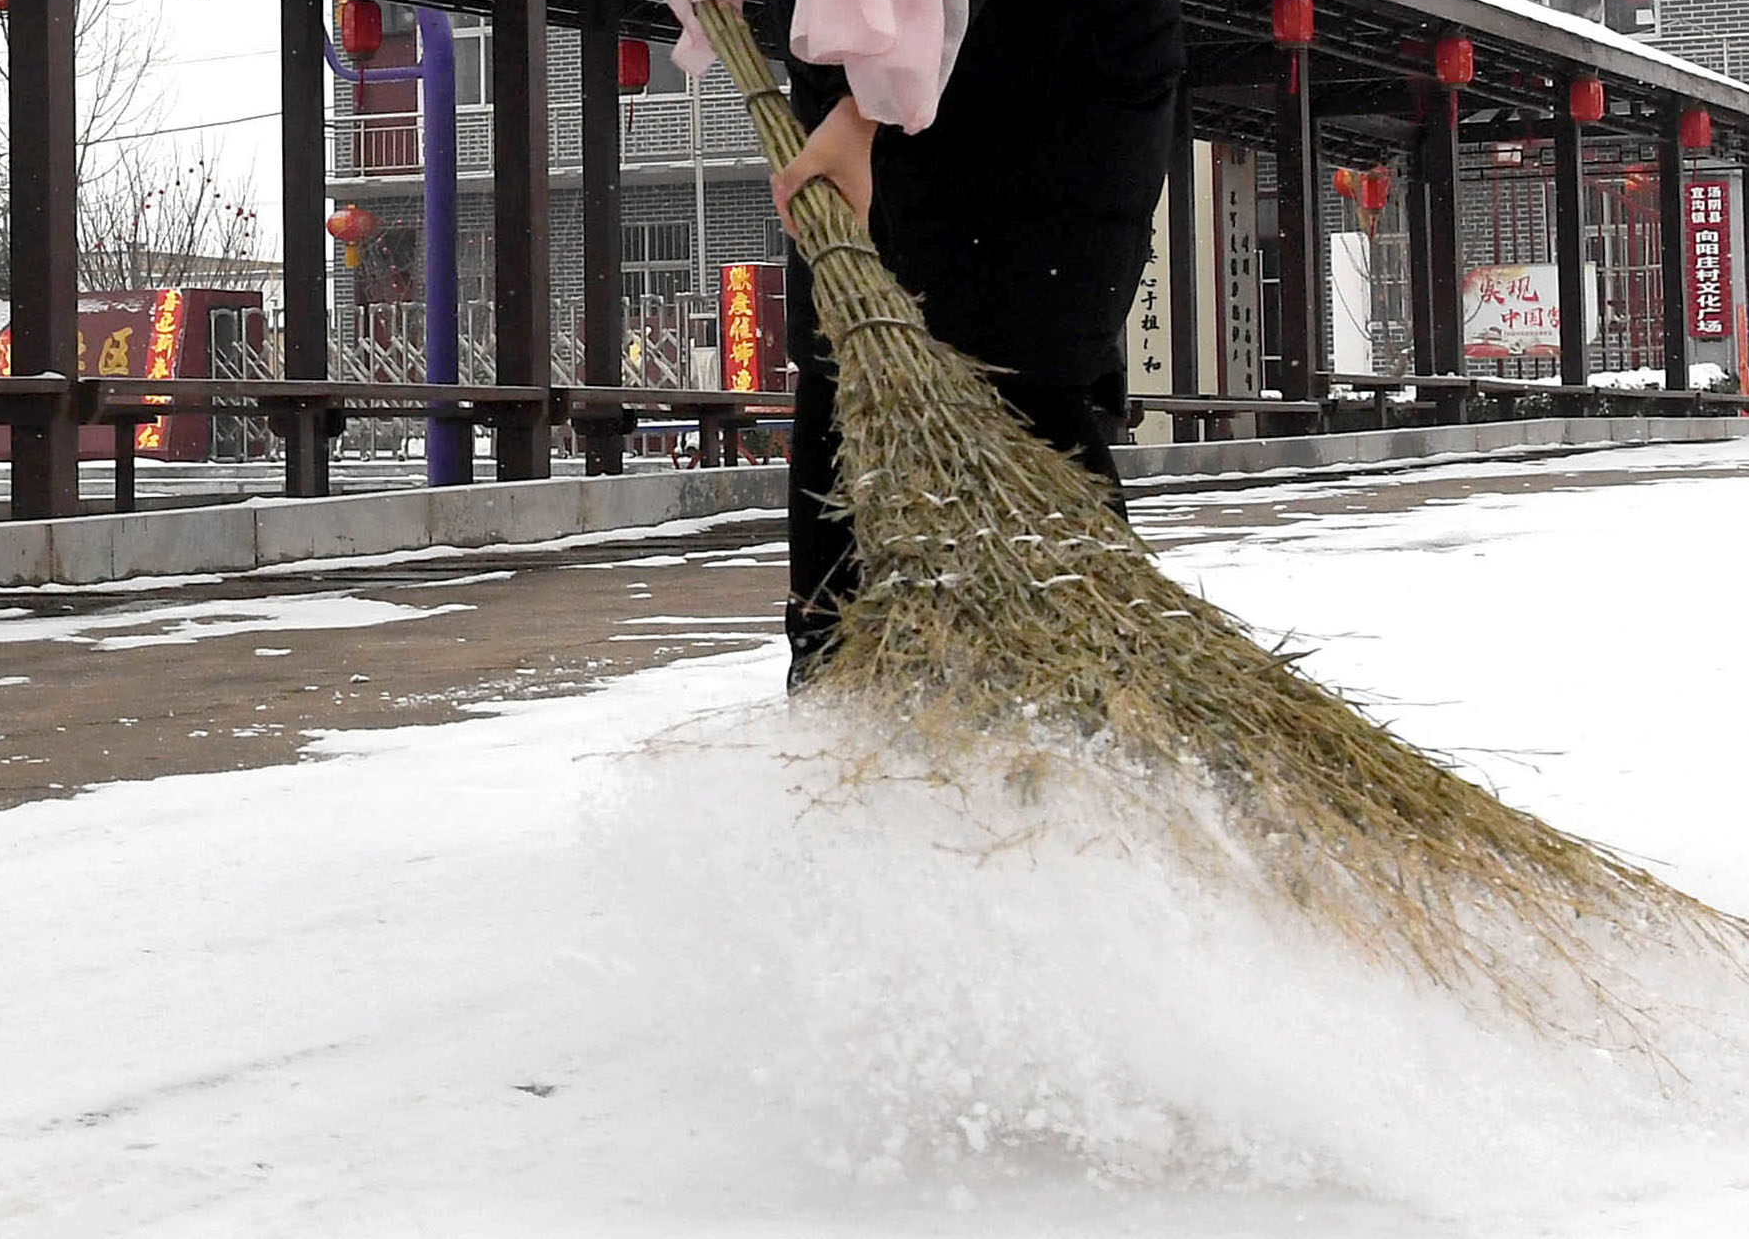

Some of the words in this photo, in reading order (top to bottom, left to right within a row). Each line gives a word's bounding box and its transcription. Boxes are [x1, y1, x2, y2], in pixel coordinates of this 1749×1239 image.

[1480, 275, 1539, 304] 实现
[1695, 230, 1722, 333] 向阳庄村文化广场
